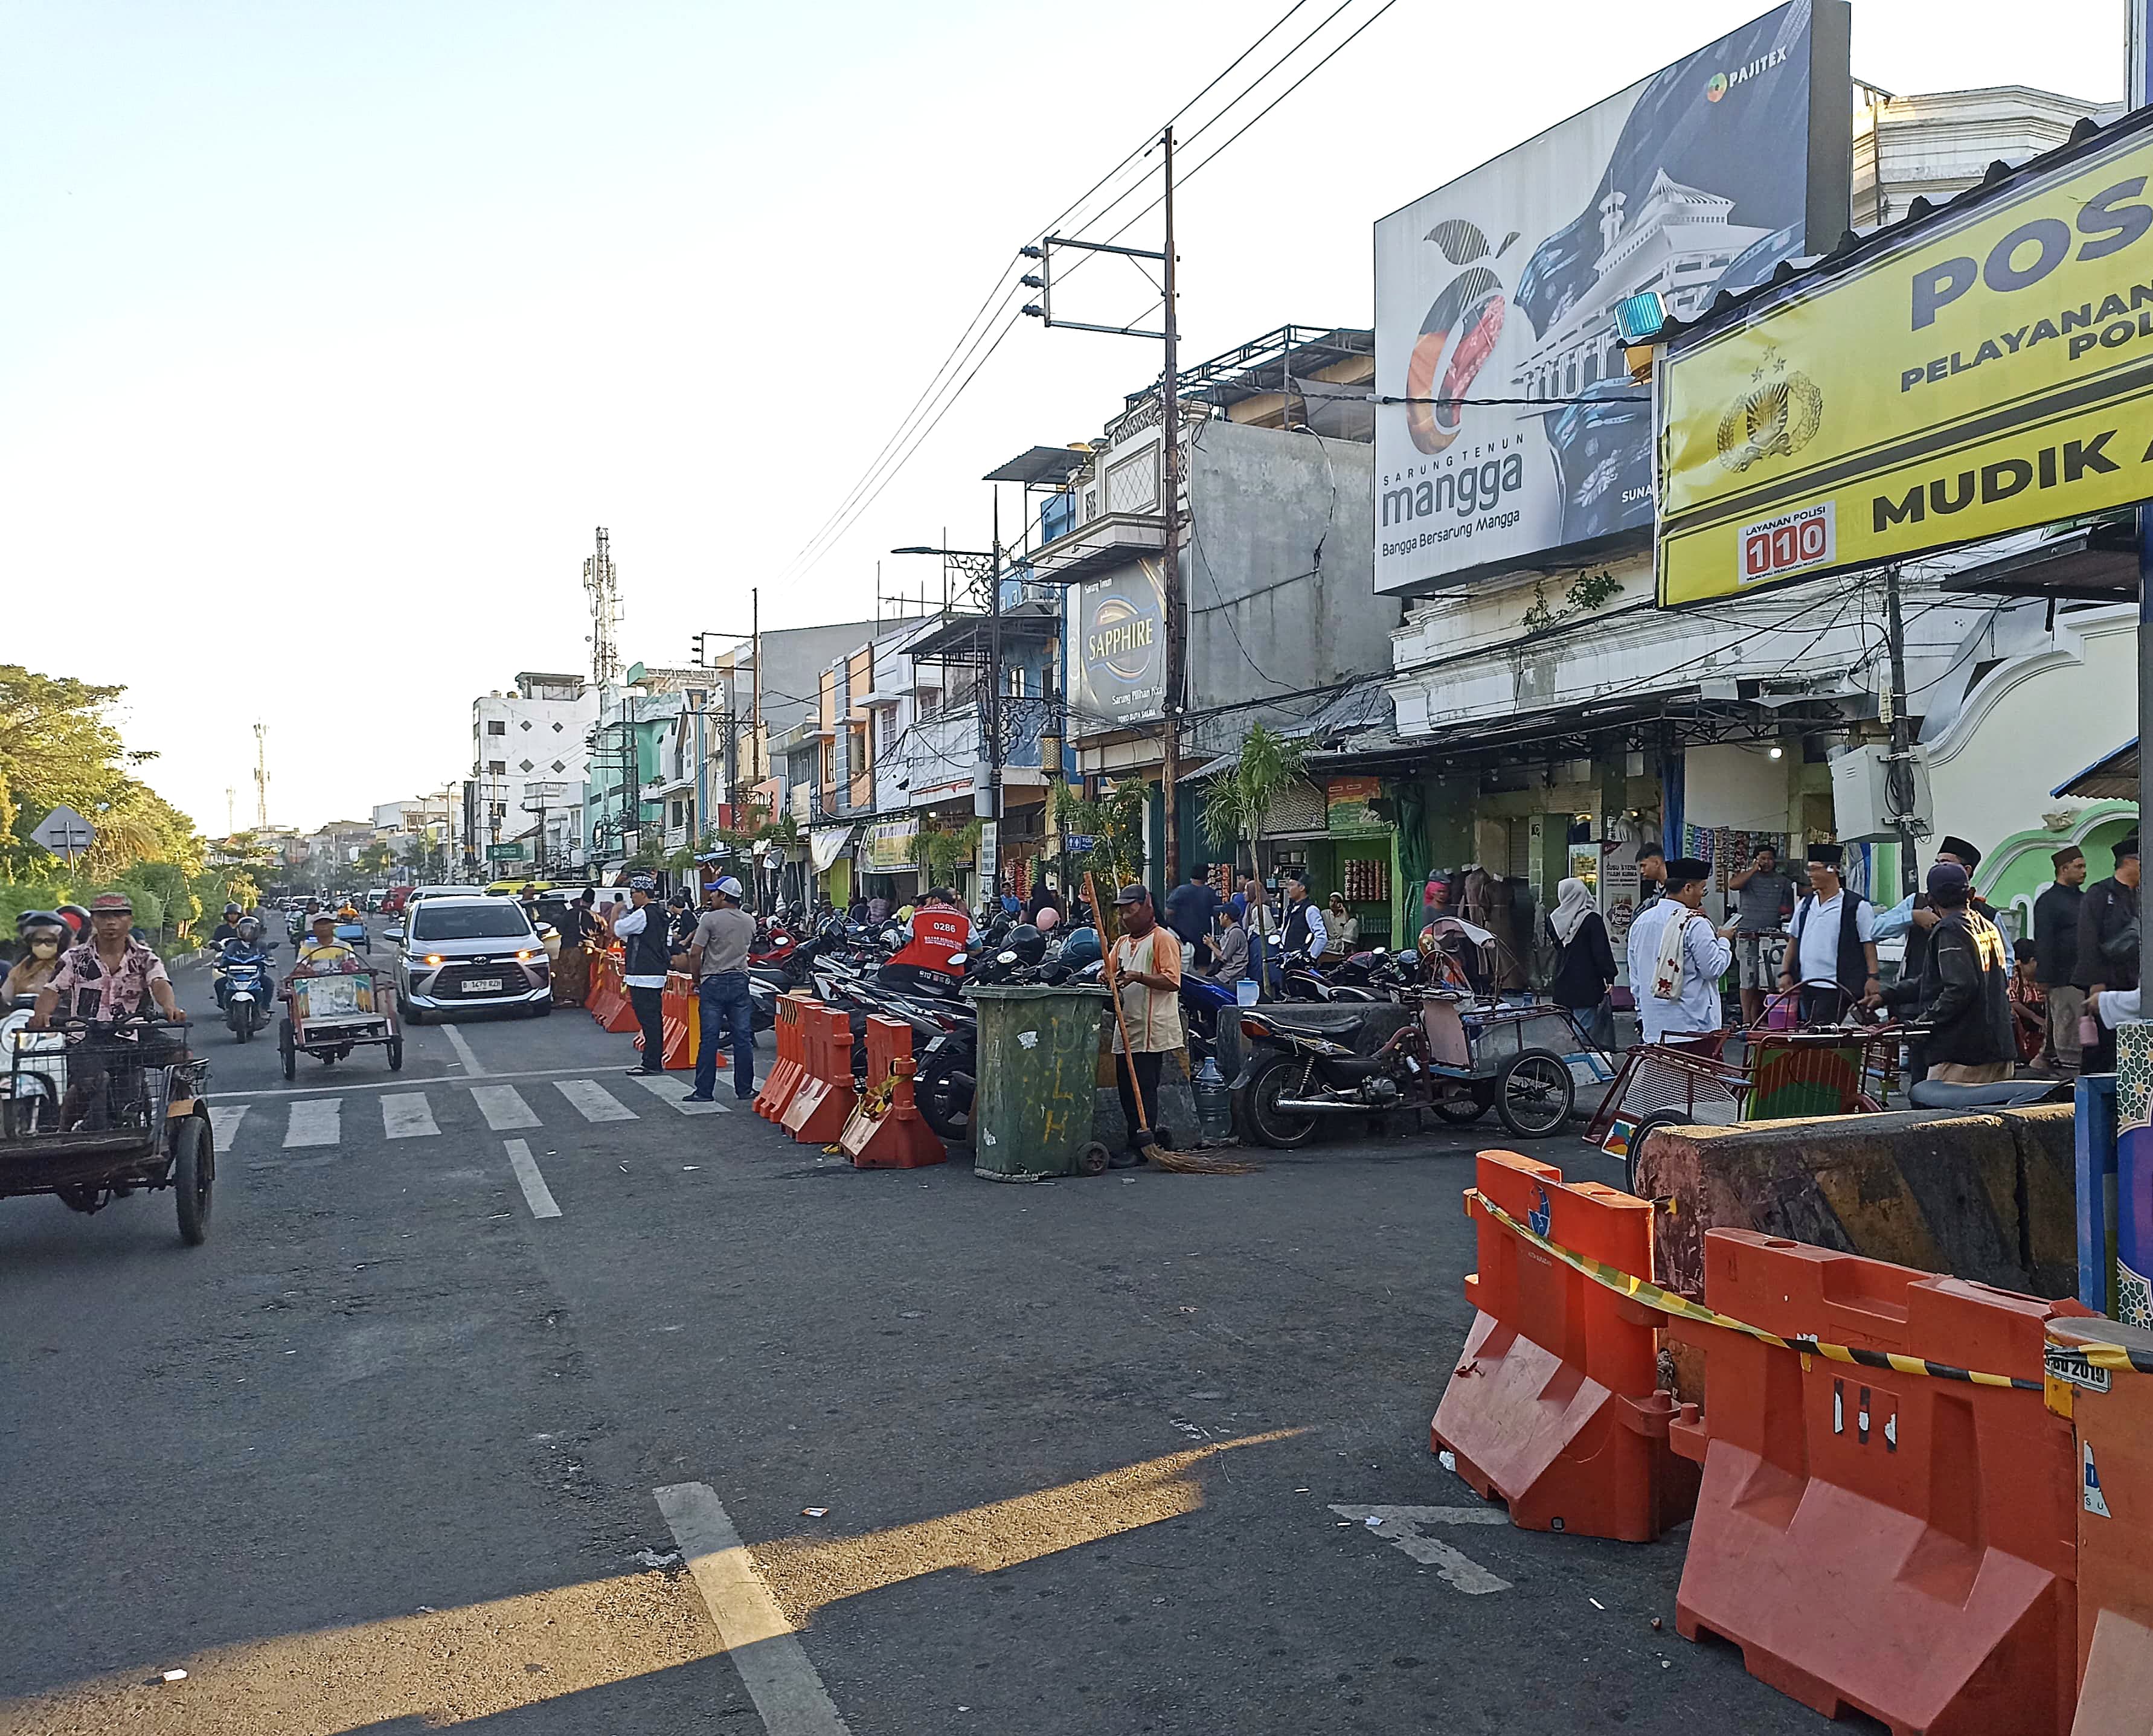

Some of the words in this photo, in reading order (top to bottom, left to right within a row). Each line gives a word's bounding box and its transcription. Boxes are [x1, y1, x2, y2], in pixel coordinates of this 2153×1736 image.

[1730, 43, 1787, 88] PAJITEX
[1911, 176, 2152, 332] POS
[1901, 279, 2153, 393] PELAYANAN
[1384, 455, 1453, 485] SARUNG
[1462, 433, 1523, 461] TENUN
[1873, 429, 2121, 533] MUDIK
[1383, 453, 1523, 527] mangga
[1383, 538, 1417, 557] Bangga
[1420, 523, 1472, 548] Bersarung
[1475, 510, 1519, 531] Mangga
[1746, 517, 1791, 536] LAYANAN
[1794, 506, 1826, 521] POLISI
[1750, 524, 1823, 568] 110
[1089, 618, 1154, 661] SAPPHIRE
[1112, 694, 1131, 705] Sarung
[933, 922, 956, 933] 0286
